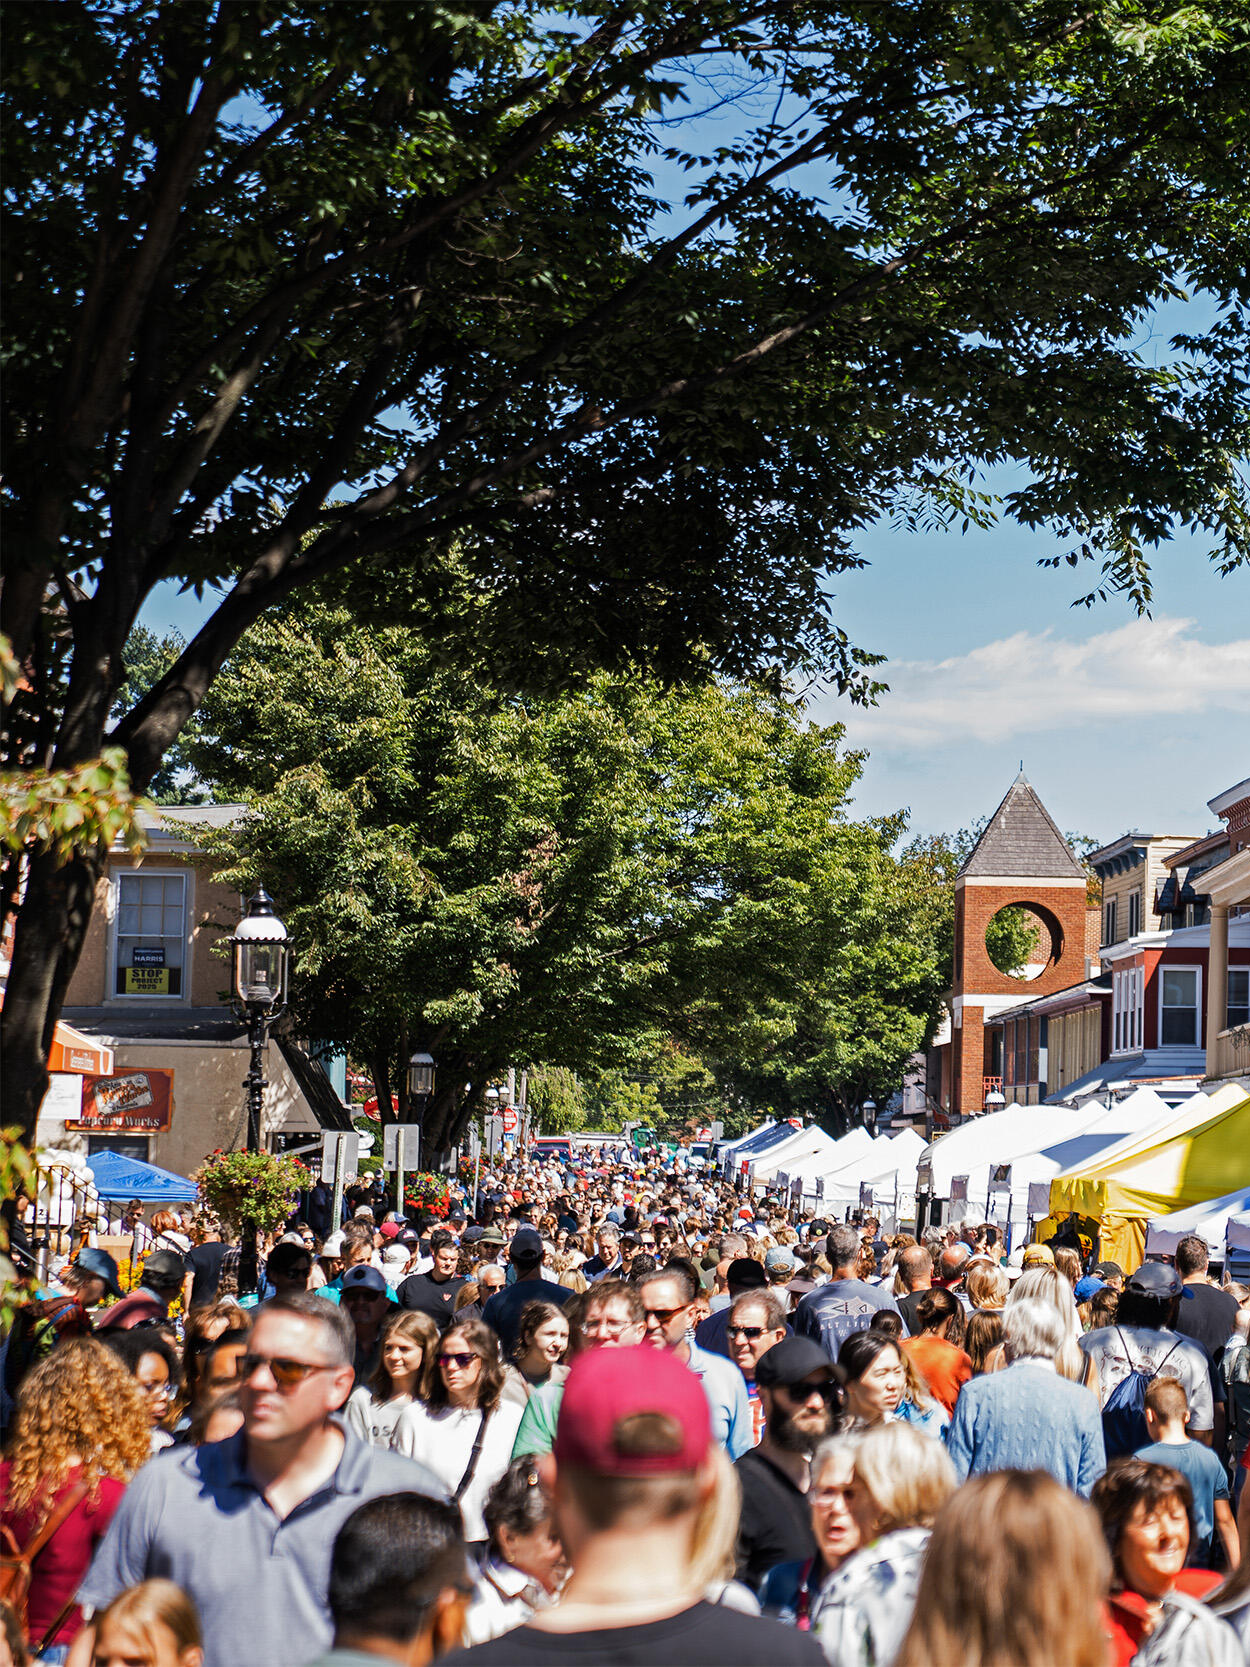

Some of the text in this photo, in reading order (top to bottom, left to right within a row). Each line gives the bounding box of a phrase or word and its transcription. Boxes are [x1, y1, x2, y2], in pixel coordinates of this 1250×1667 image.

[132, 969, 162, 977] STOP
[125, 1115, 160, 1126] Works
[820, 1321, 839, 1330] ALT
